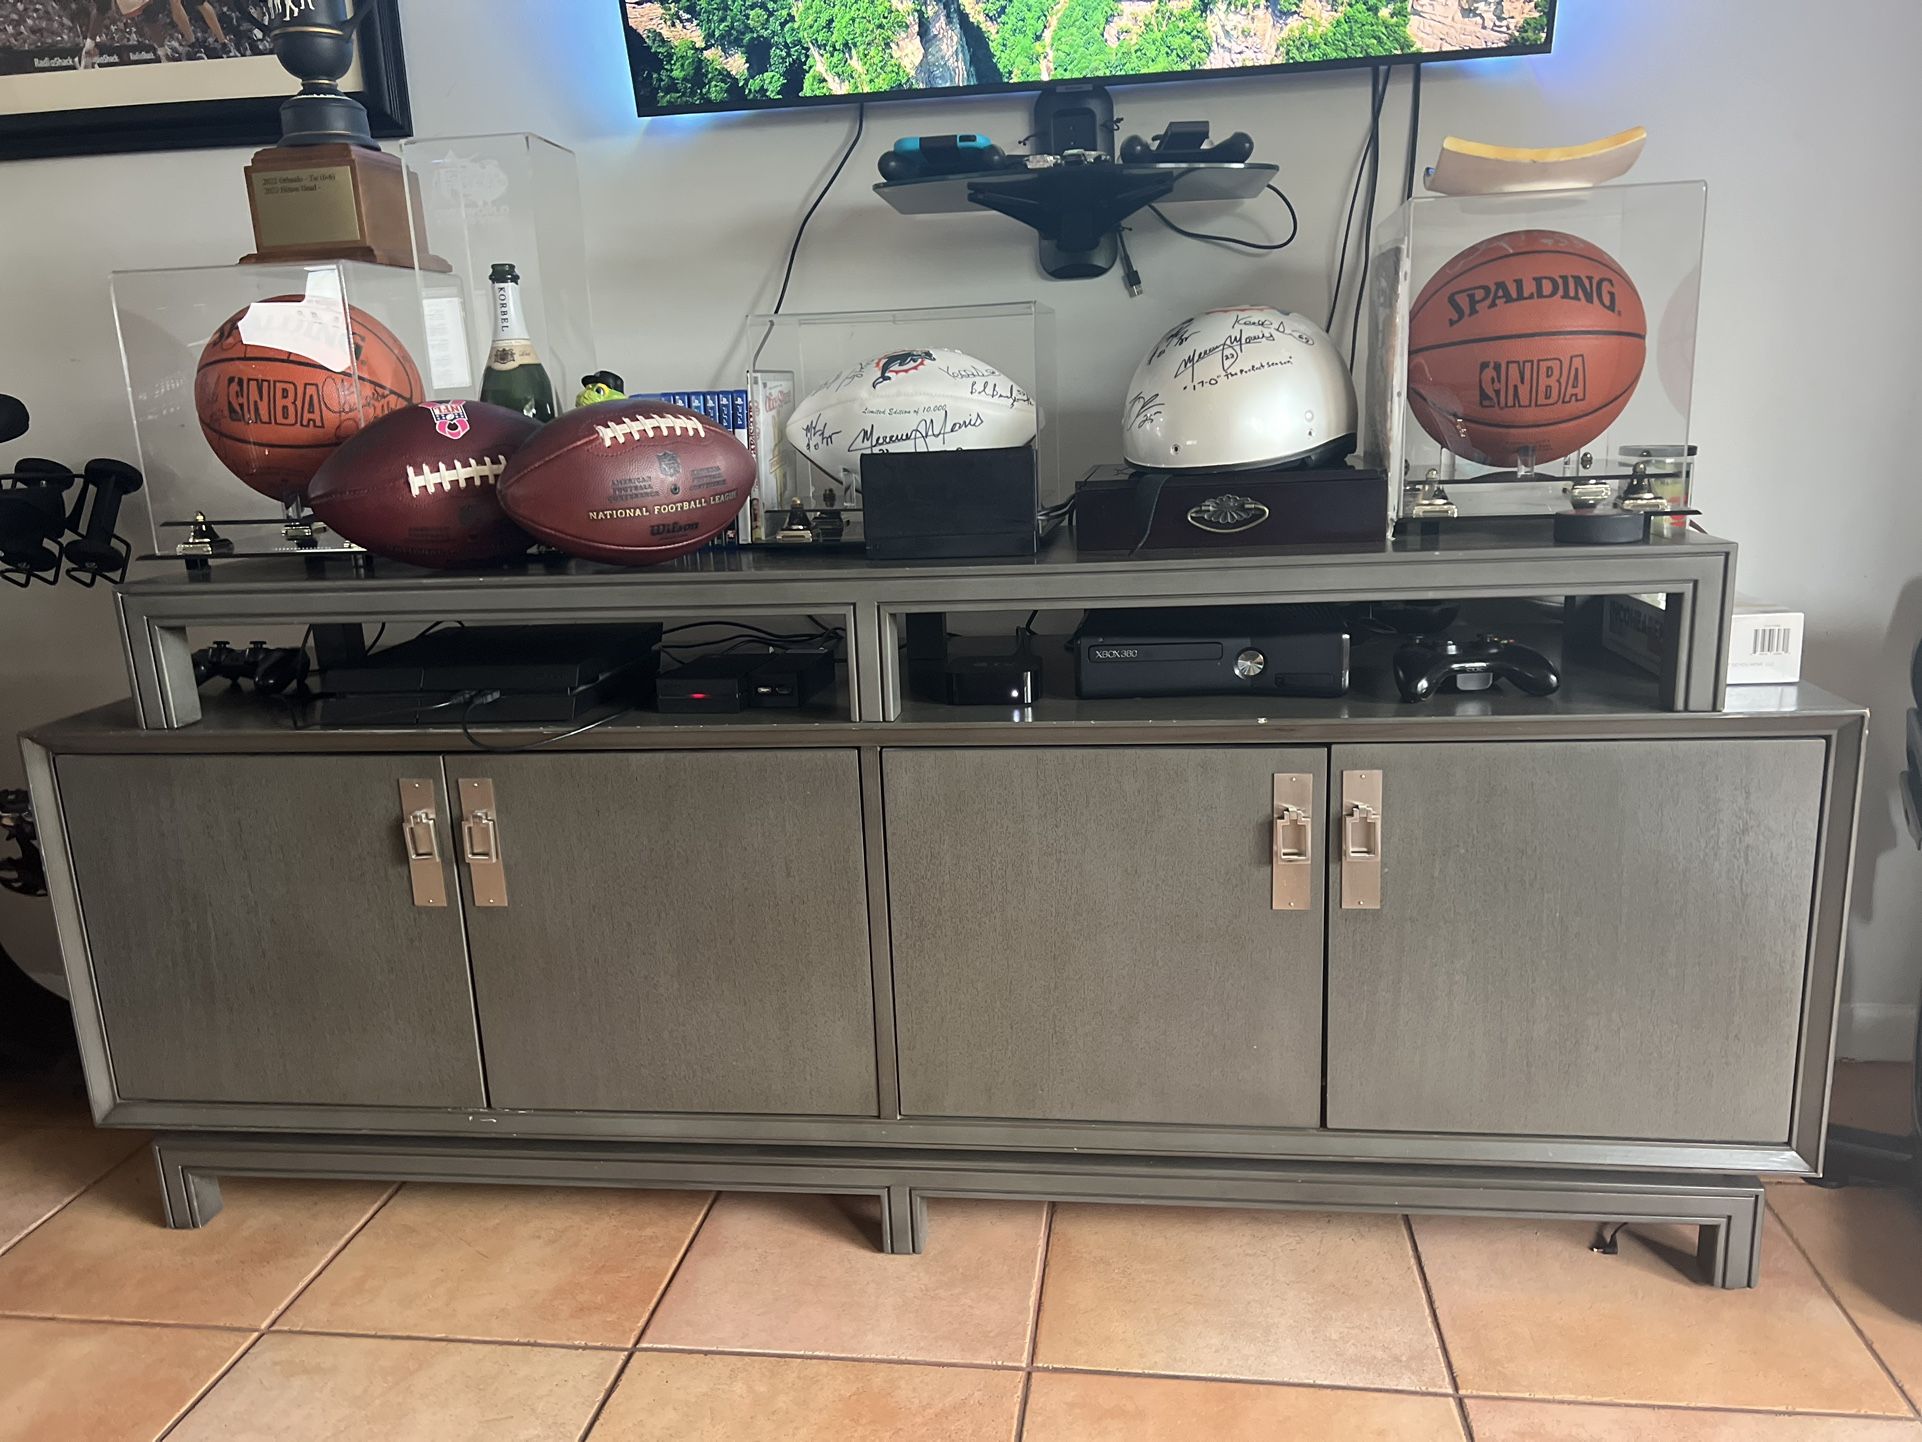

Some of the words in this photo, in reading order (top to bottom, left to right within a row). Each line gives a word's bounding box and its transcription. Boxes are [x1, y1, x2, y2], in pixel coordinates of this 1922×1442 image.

[498, 286, 509, 332] KORBEL
[1447, 274, 1617, 328] SPALDING
[246, 378, 325, 429] NBA
[1504, 354, 1587, 409] NBA
[862, 407, 886, 415] Limited
[888, 407, 911, 416] Edition
[913, 407, 920, 416] of
[588, 507, 650, 520] NATIONAL
[654, 498, 708, 515] FOOTBALL
[710, 489, 738, 505] LEAGUE
[650, 521, 699, 537] Wilson
